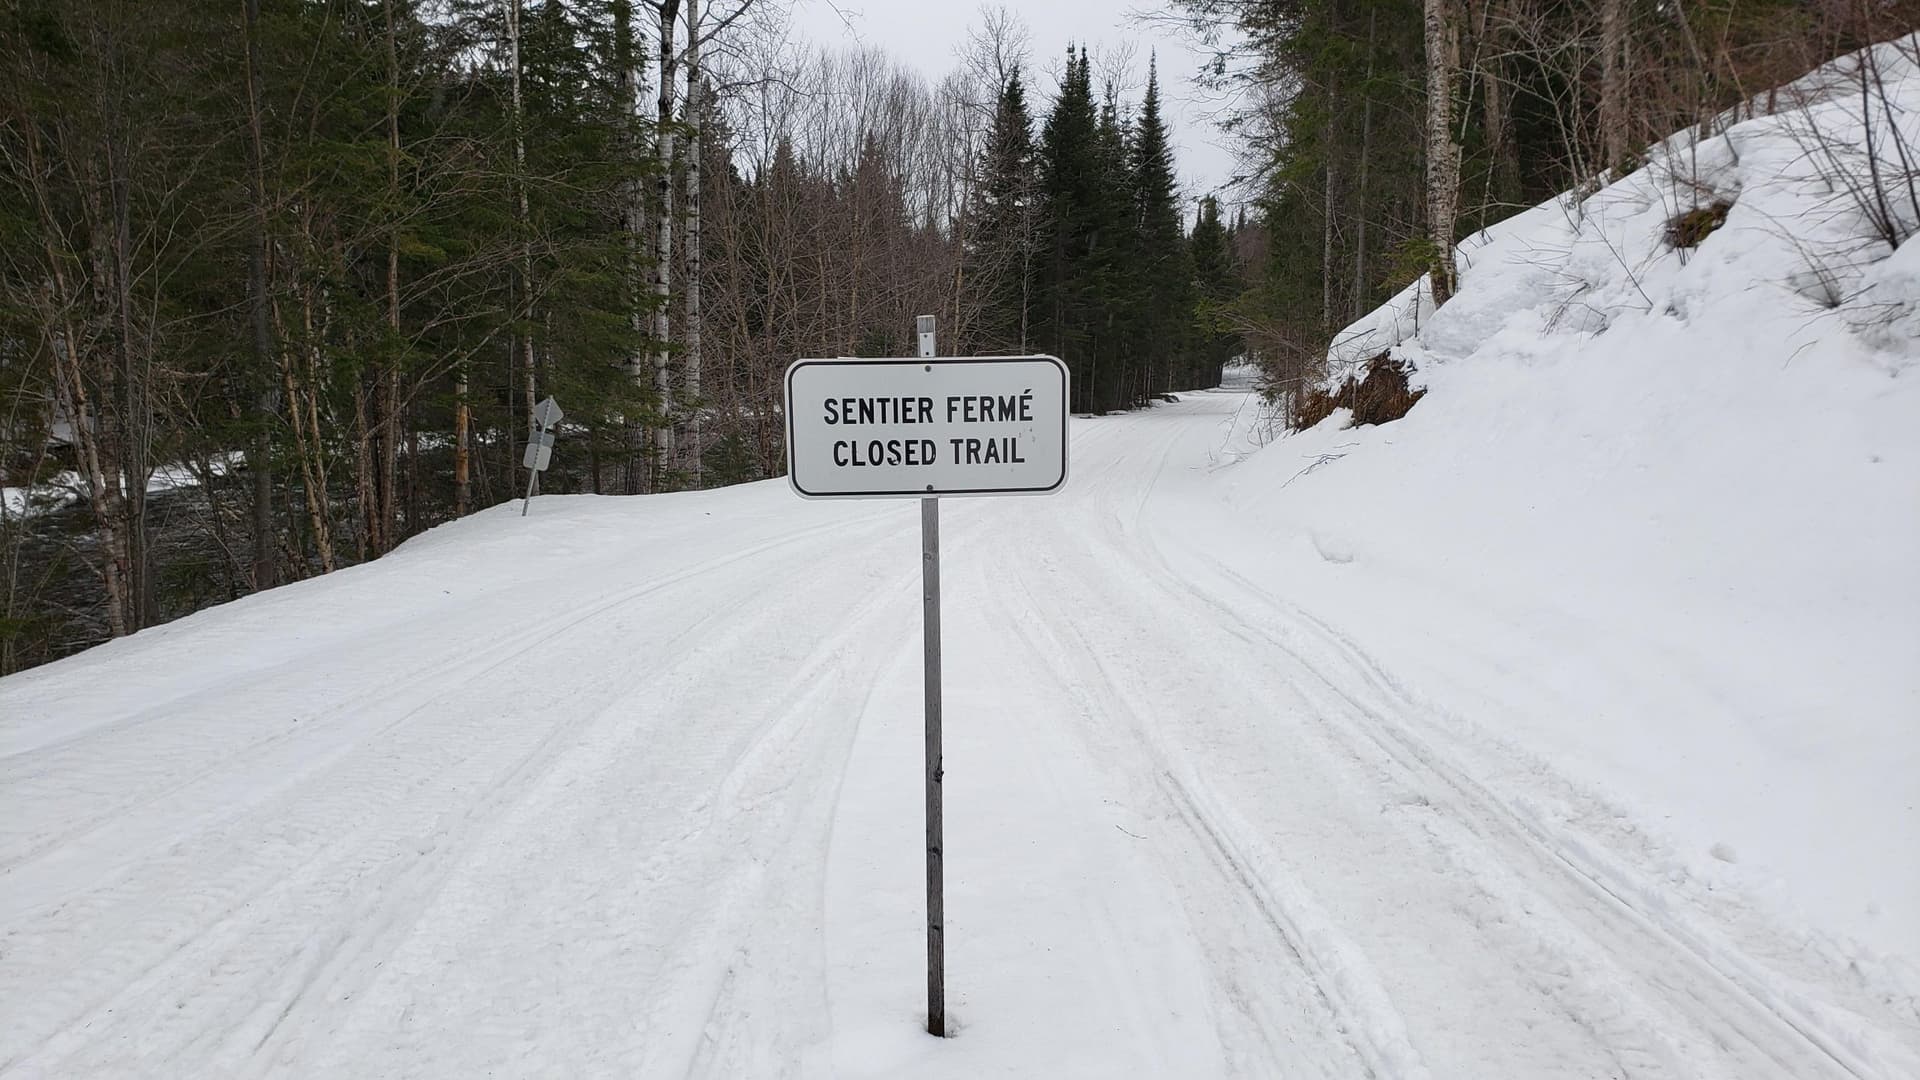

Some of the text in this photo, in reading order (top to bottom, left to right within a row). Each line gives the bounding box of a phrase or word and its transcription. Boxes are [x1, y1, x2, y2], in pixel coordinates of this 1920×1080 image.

[823, 388, 1034, 425] SENTIER FERMÉ
[833, 437, 1026, 467] CLOSED TRAIL
